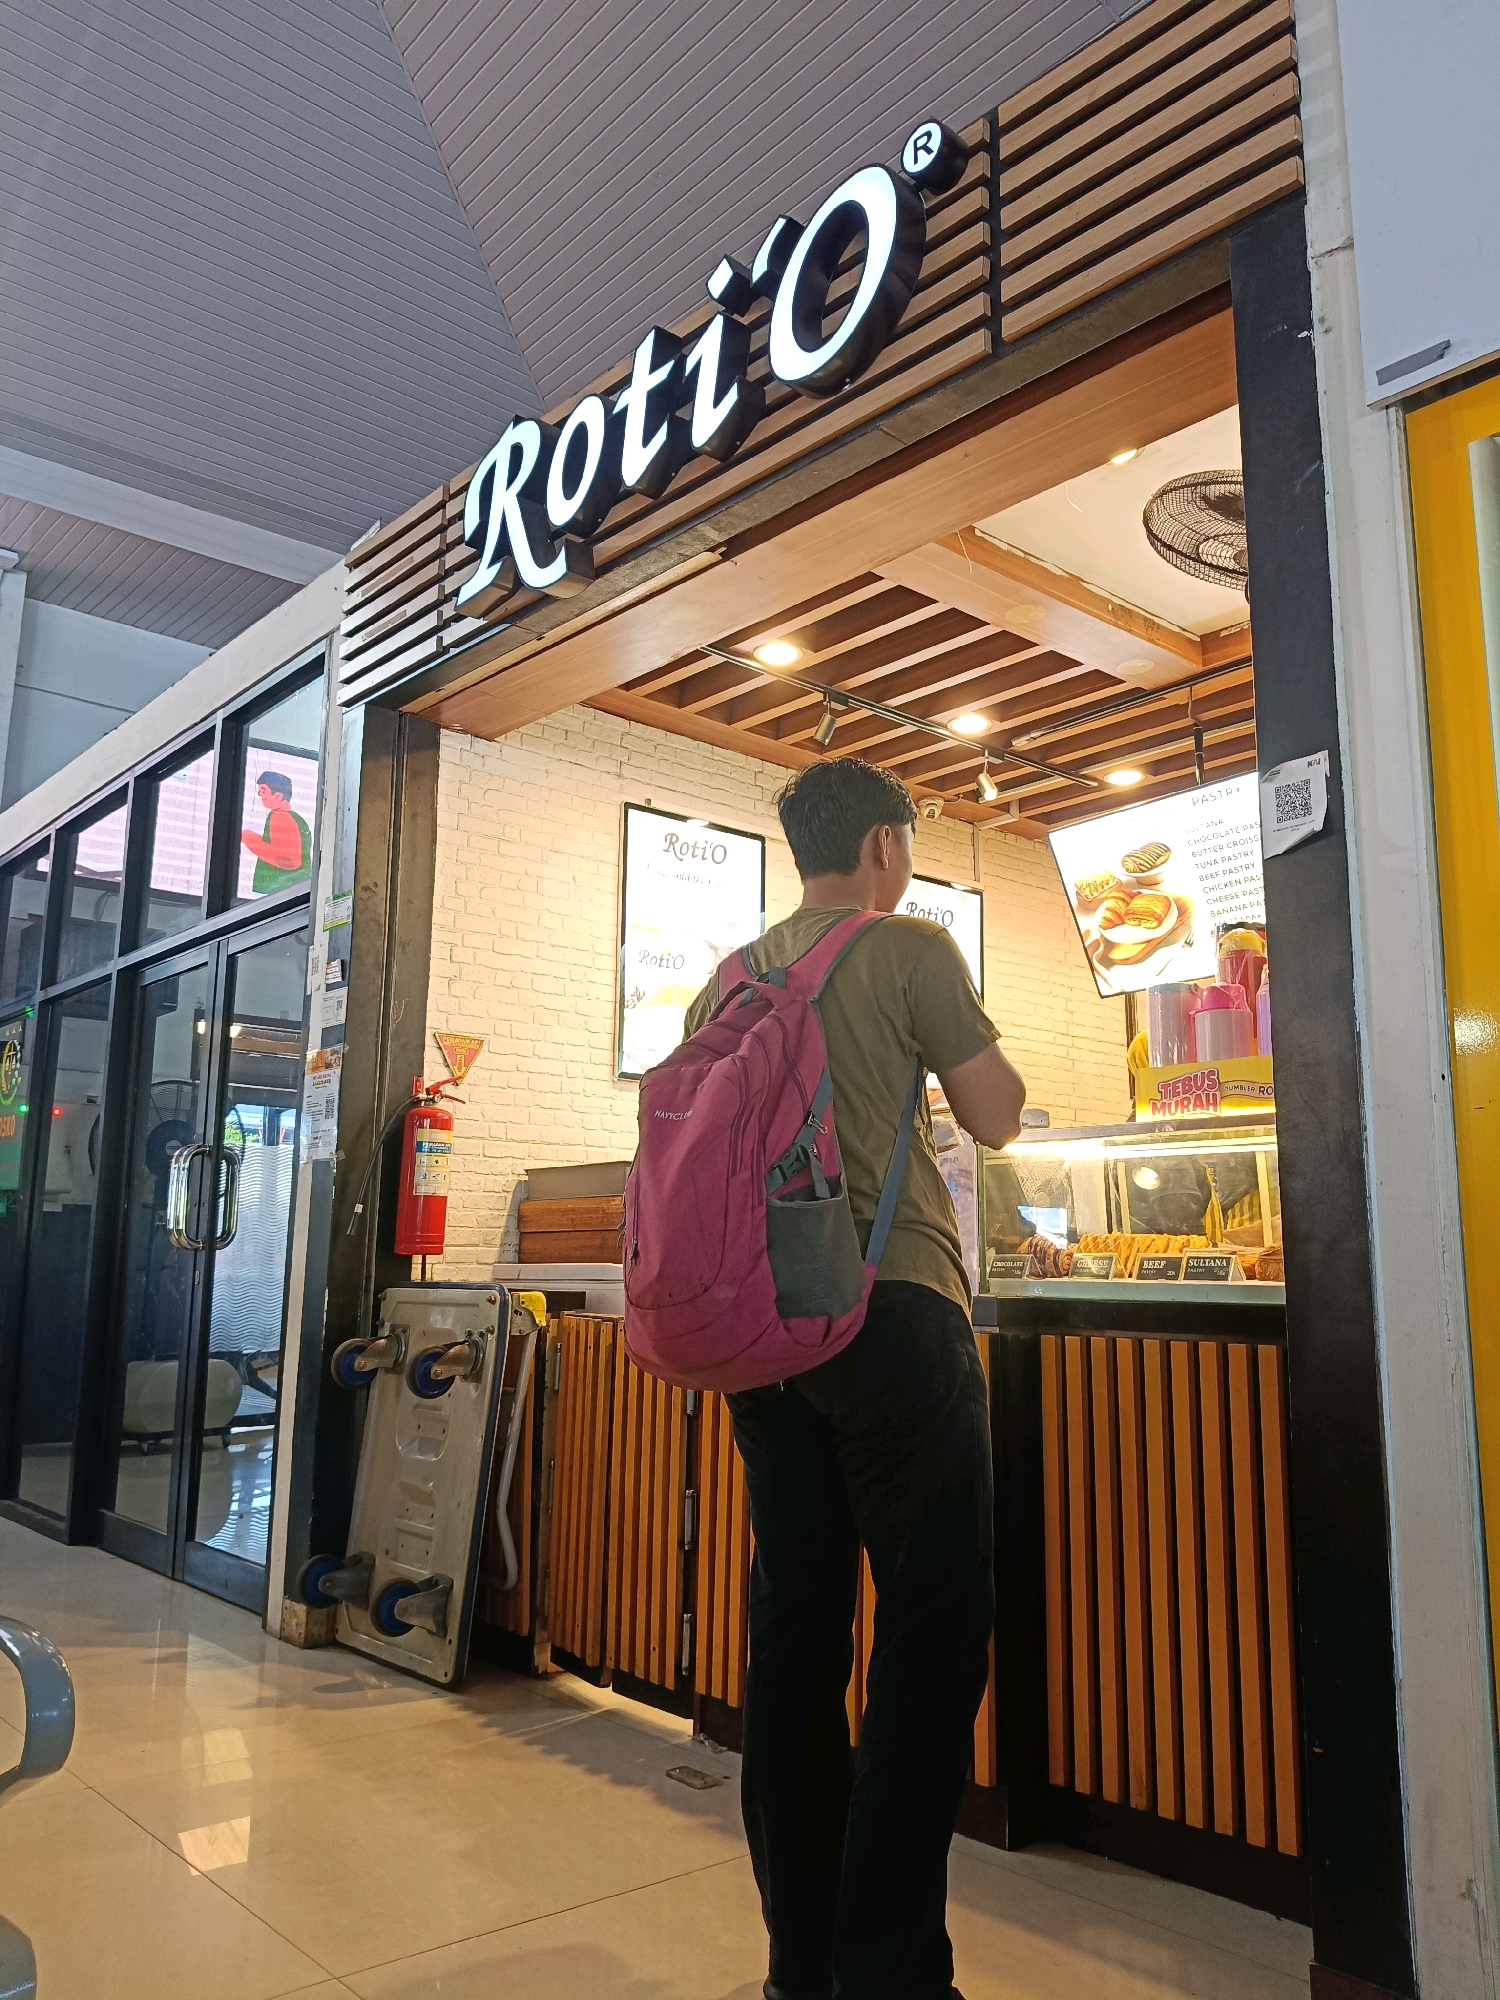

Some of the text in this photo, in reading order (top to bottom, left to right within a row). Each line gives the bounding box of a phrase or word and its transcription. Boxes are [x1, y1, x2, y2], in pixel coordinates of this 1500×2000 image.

[1191, 786, 1240, 806] PASTRY
[1187, 826, 1241, 846] CHOCOLATE
[1191, 834, 1260, 858] BUTTER CROISS
[1195, 849, 1254, 870] TUNA PASTRY
[1198, 861, 1255, 882] BEEF PASTRY
[1202, 878, 1242, 894] CHICKEN
[1206, 892, 1241, 905] CHEESE
[1210, 904, 1248, 918] BANANA
[1160, 1069, 1218, 1100] TEBUS
[1224, 1084, 1256, 1093] TUMBLER
[1151, 1092, 1218, 1117] MURAH
[1077, 1259, 1108, 1268] CHEESE
[1142, 1260, 1167, 1269] BEEF
[1188, 1258, 1227, 1267] SULTANA
